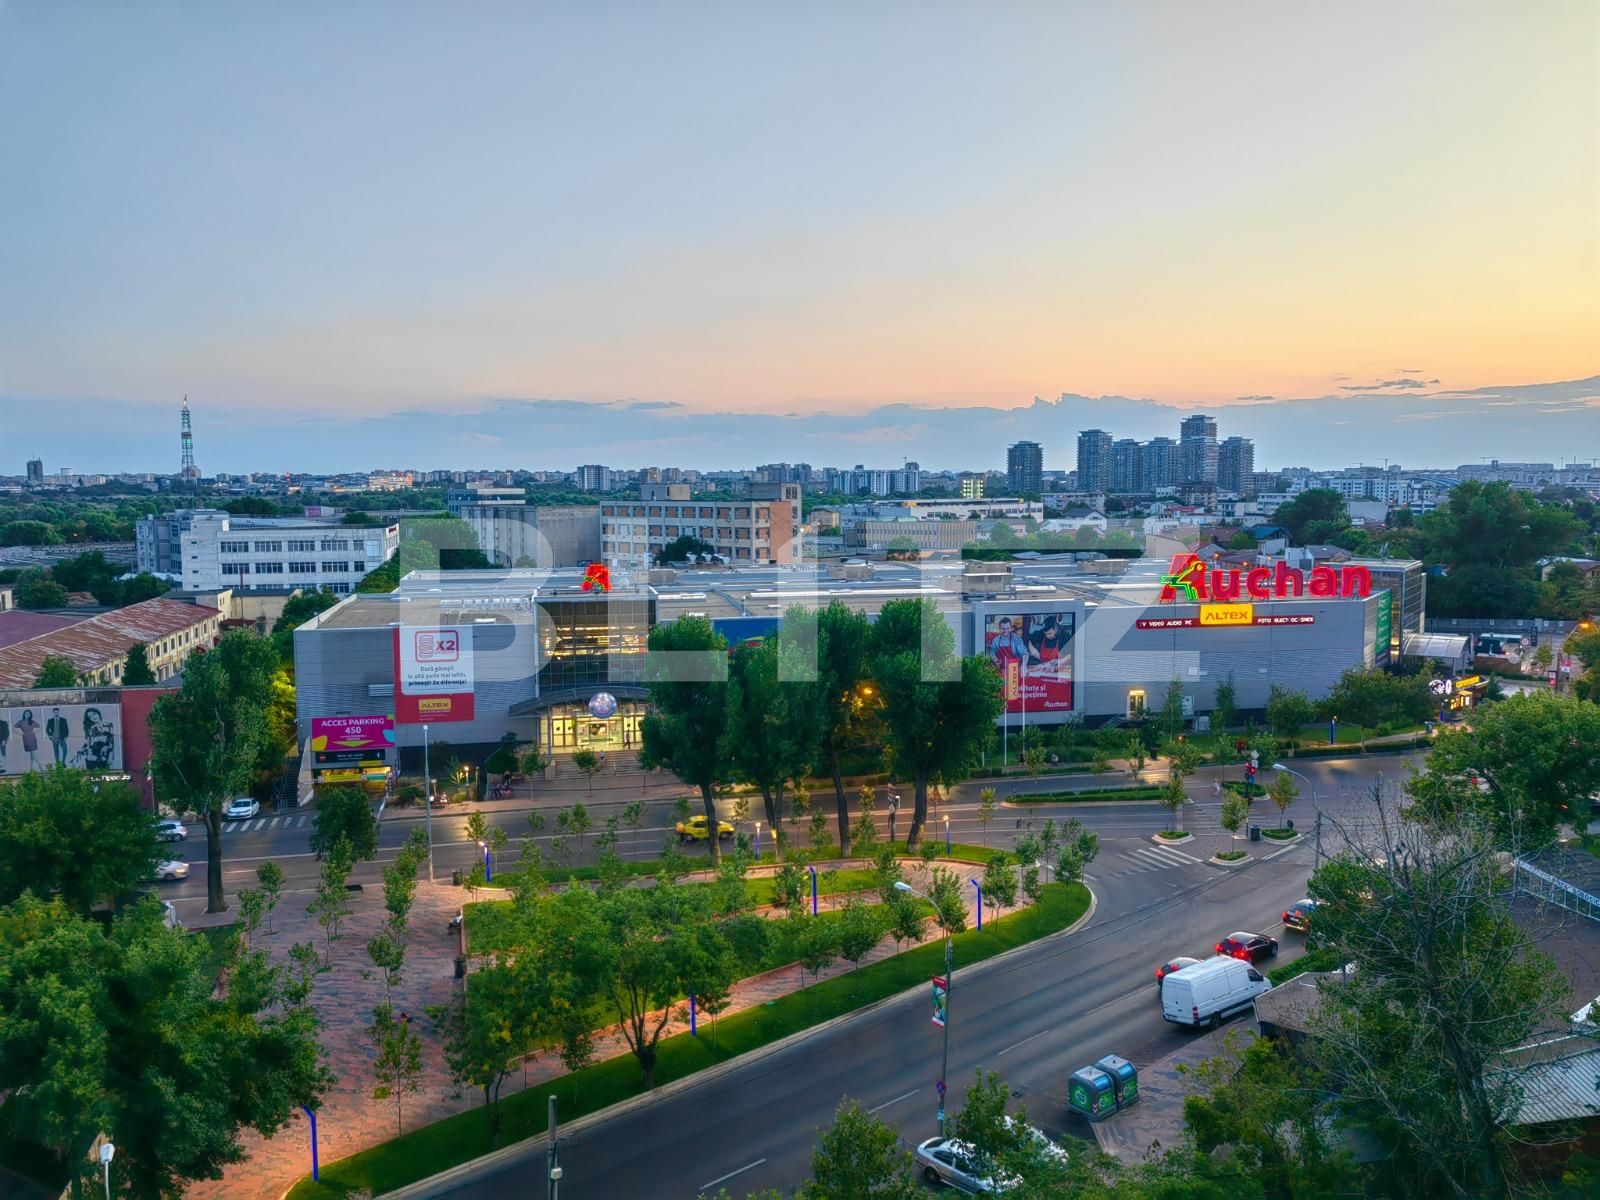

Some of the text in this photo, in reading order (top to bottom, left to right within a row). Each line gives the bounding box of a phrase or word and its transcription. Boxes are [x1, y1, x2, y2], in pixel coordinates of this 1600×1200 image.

[1160, 553, 1372, 600] Auchan
[321, 717, 385, 727] ACCES PARKING
[345, 726, 362, 734] 450
